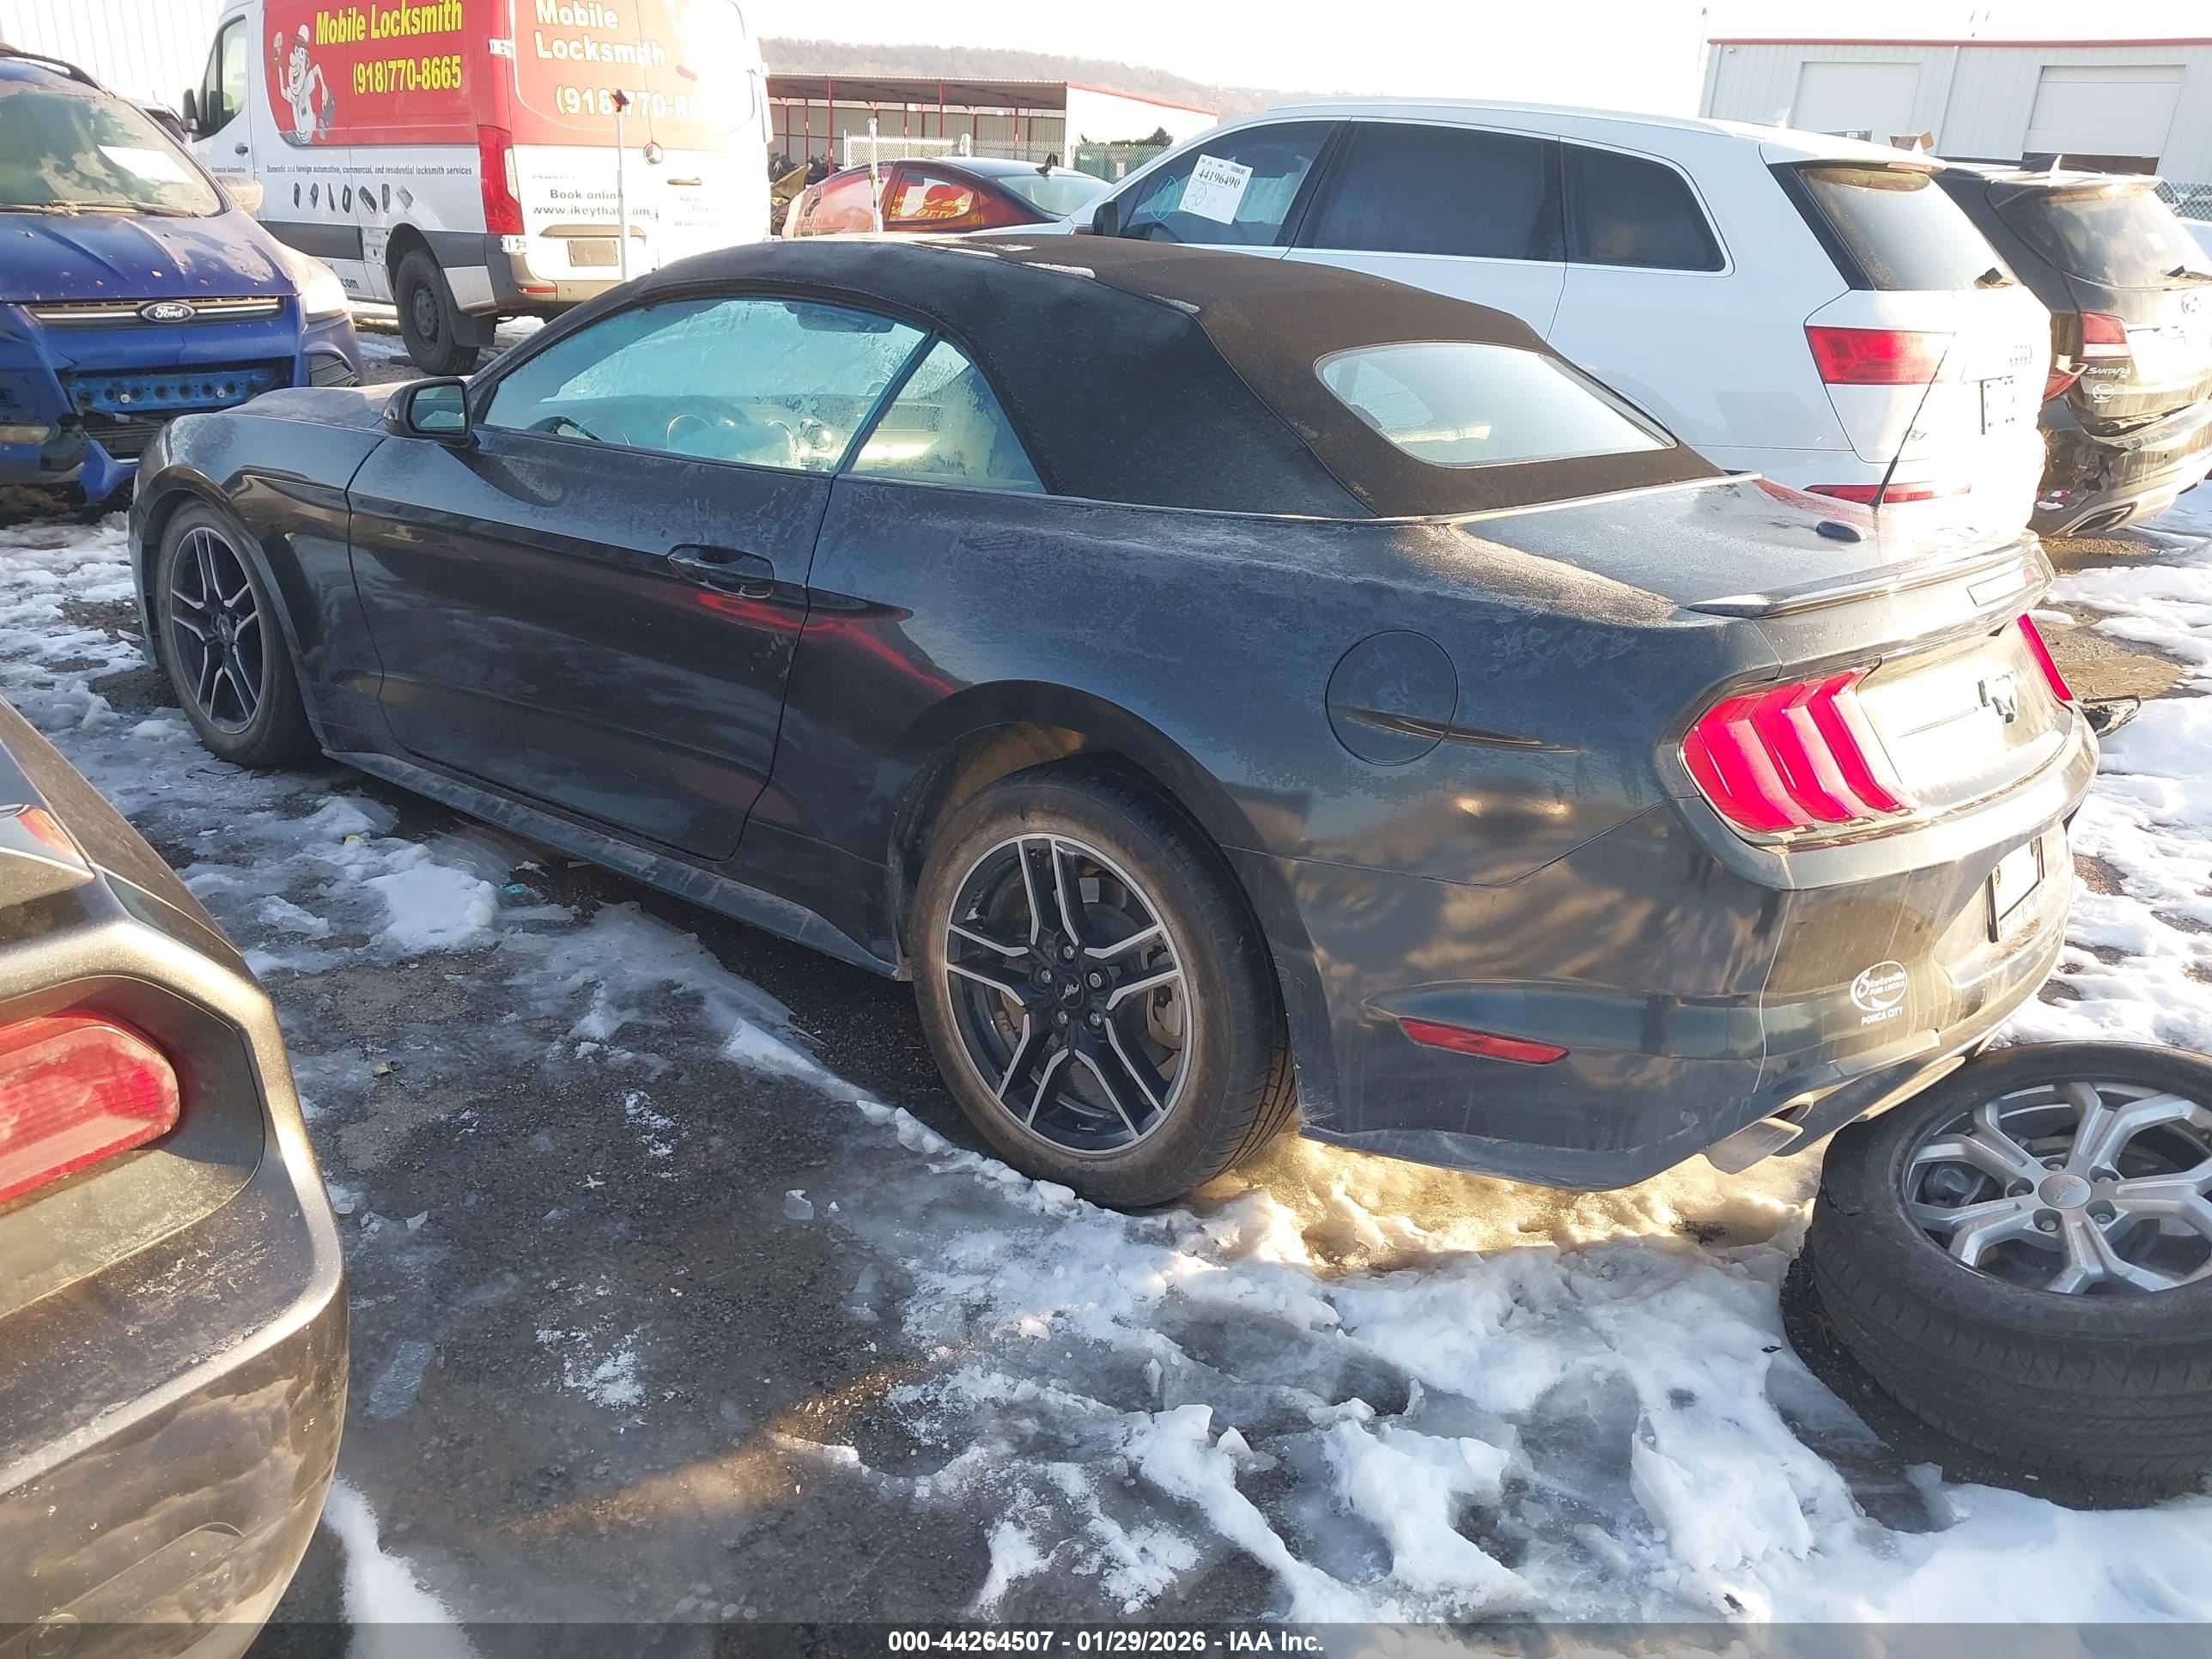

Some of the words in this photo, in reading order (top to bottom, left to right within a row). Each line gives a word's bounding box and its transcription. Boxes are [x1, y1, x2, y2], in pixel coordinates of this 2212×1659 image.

[315, 7, 366, 46] Mobile
[370, 0, 463, 40] Locksmith
[534, 0, 619, 29] Mobile
[533, 29, 667, 66] Locksmith
[353, 54, 462, 95] (918)770-8665
[266, 164, 286, 173] Domestic
[295, 164, 312, 174] foreign
[374, 166, 384, 174] and
[386, 165, 415, 175] residential
[416, 165, 445, 175] locksmith
[446, 167, 472, 175] services
[1198, 167, 1241, 189] 44196490
[550, 189, 582, 199] Book
[155, 306, 184, 318] Ford
[1887, 1006, 1904, 1018] CITY
